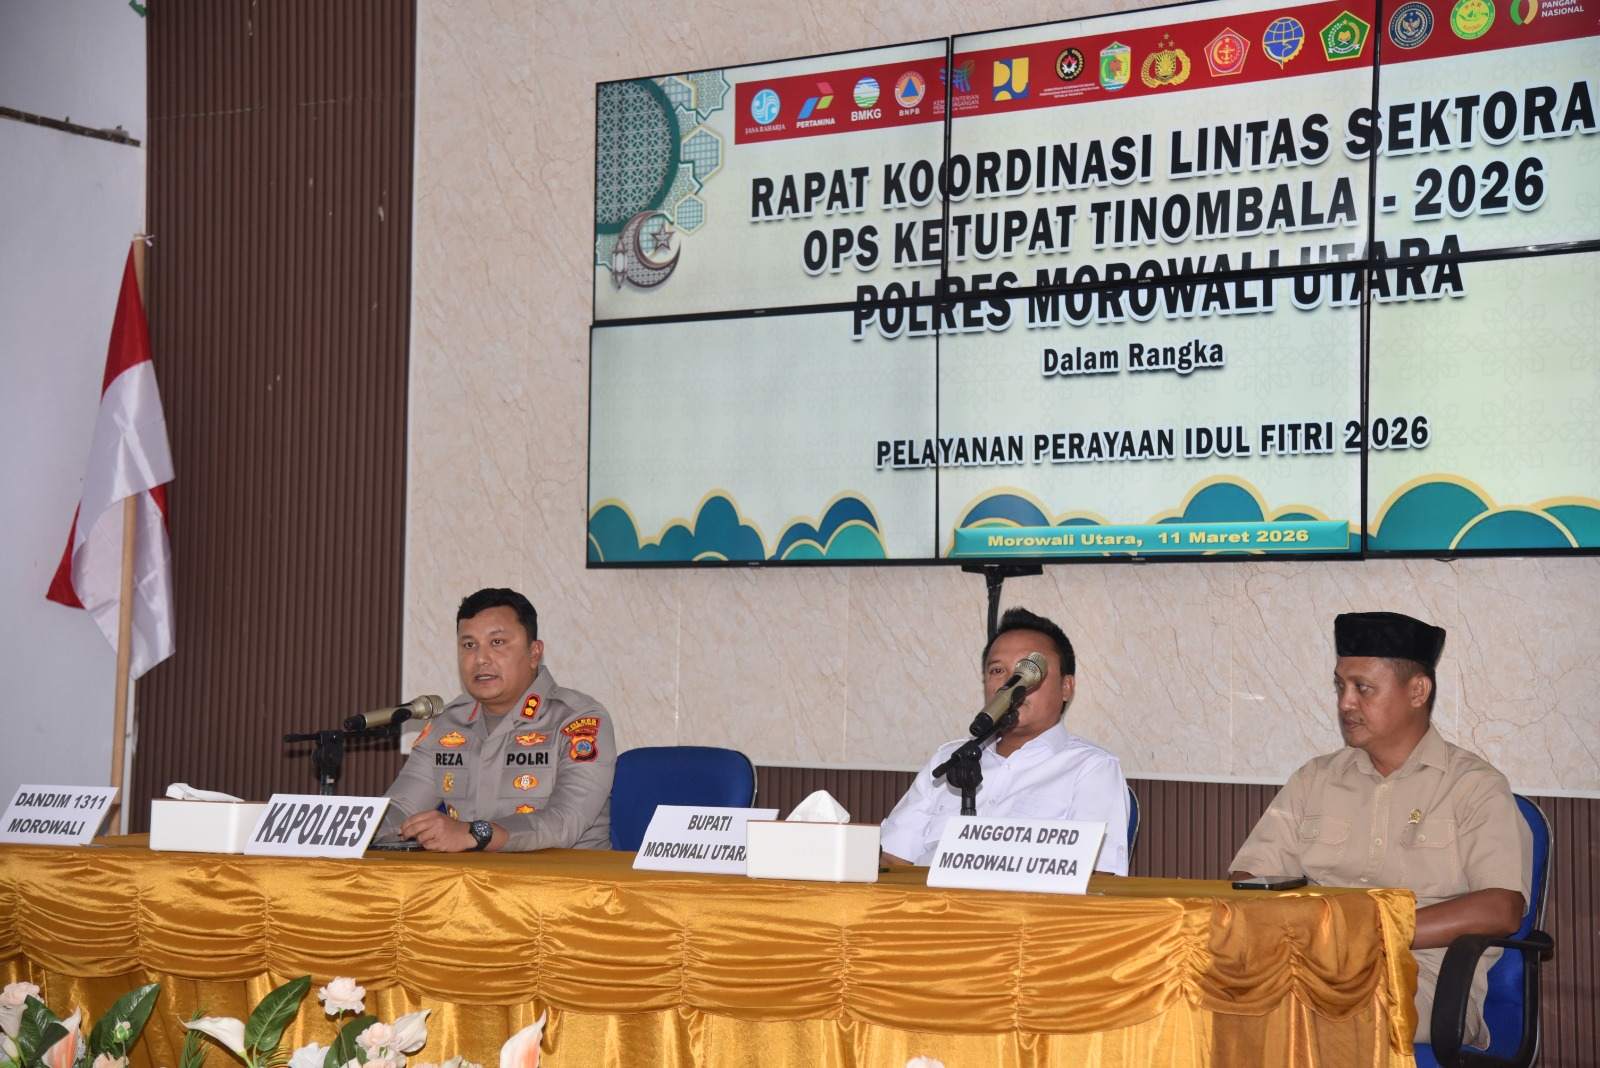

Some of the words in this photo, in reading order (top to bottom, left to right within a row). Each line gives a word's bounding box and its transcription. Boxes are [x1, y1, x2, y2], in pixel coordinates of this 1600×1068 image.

[1541, 0, 1577, 9] PANGAN
[1541, 5, 1585, 17] NASIONAL
[851, 108, 882, 121] BMKG
[898, 107, 921, 117] BNPB
[796, 118, 836, 128] PERTAMINA
[751, 166, 870, 218] RAPAT
[883, 134, 1152, 205] KOORDINASI
[1170, 113, 1329, 175] LINTAS
[803, 225, 879, 271] OPS
[894, 204, 1076, 264] KETUPAT
[1090, 177, 1357, 245] TINOMBALA
[1414, 157, 1545, 217] 2026
[853, 271, 1018, 336] POLRES
[1028, 249, 1280, 325] MOROWALI
[1293, 234, 1465, 305] UTARA
[1043, 347, 1119, 373] Dalam
[1129, 339, 1224, 371] Rangka
[876, 435, 1024, 466] PELAYANAN
[1034, 429, 1174, 460] PERAYAAN
[1185, 426, 1250, 455] IDUL
[1261, 422, 1333, 450] FITRI
[1345, 416, 1429, 449] 2026
[987, 534, 1075, 547] Morowali
[1081, 533, 1143, 548] Utara,
[1158, 532, 1181, 544] 11
[1189, 531, 1250, 544] Maret
[1256, 529, 1309, 543] 2026
[435, 752, 463, 766] REZA
[506, 752, 549, 766] POLRI
[15, 792, 72, 809] DANDIM
[74, 795, 107, 810] 1311
[7, 818, 86, 836] MOROWALI
[254, 802, 375, 847] KAPOLRES
[688, 814, 733, 831] BUPATI
[958, 824, 1033, 843] ANGGOTA
[1036, 828, 1080, 846] DPRD
[643, 841, 711, 860] MOROWALI
[939, 852, 1024, 872] MOROWALI
[1026, 857, 1078, 876] UTARA
